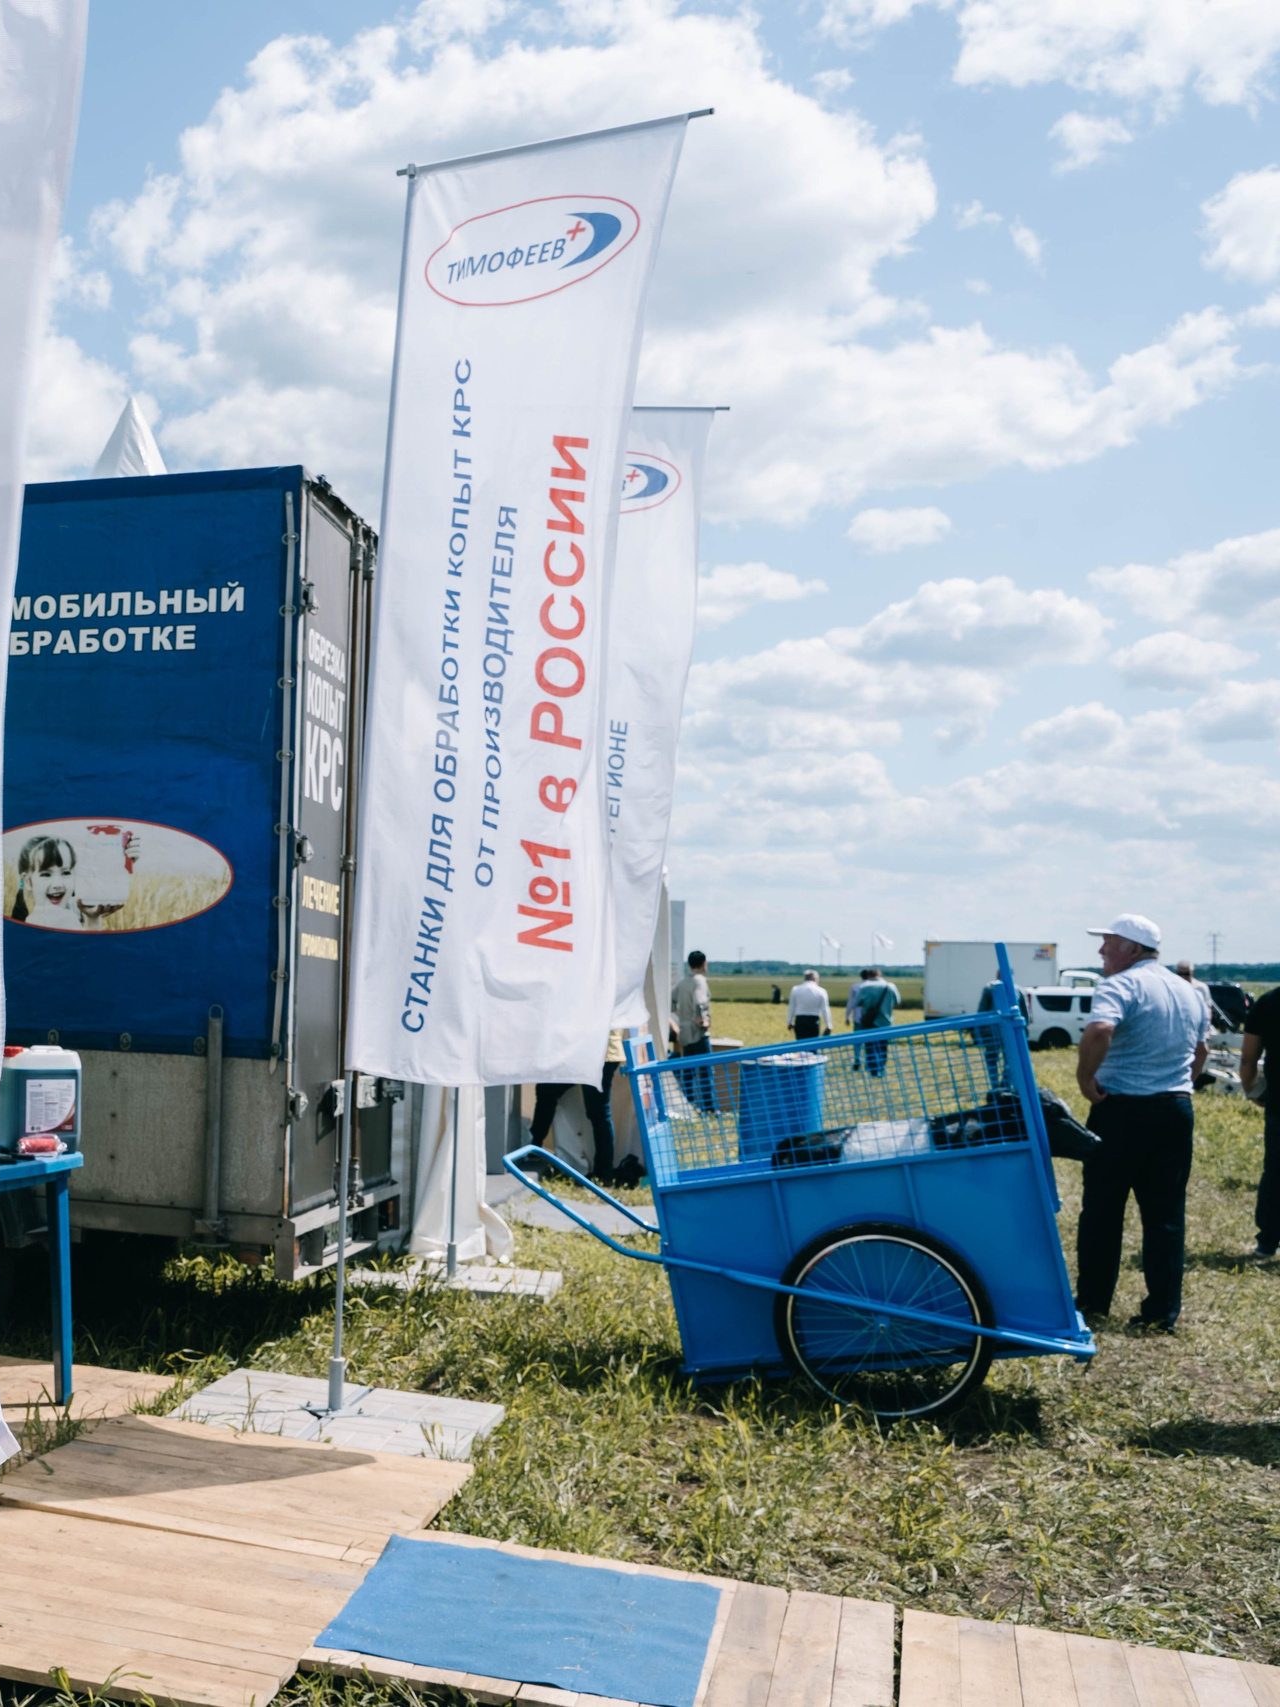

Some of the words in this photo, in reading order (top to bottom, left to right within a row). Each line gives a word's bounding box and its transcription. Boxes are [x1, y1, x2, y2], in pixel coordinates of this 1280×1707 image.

[447, 238, 567, 285] ТИМОФЕЕВ
[452, 358, 471, 438] КРС
[447, 448, 472, 577] КОПЫТ
[12, 581, 245, 621] МОБИЛЬНЫЙ
[530, 434, 589, 751] РОССИИ
[308, 628, 346, 684] ОБРЕЗКА
[434, 588, 461, 803] ОБРАБОТКИ
[482, 505, 518, 831] ПРОИЗВОДИТЕЛЯ
[307, 670, 345, 733] КОПЫТ
[304, 720, 344, 812] КРС
[426, 813, 455, 892] ДЛЯ
[475, 838, 496, 887] ОТ
[517, 838, 573, 952] №1
[401, 896, 446, 1034] СТАНКИ
